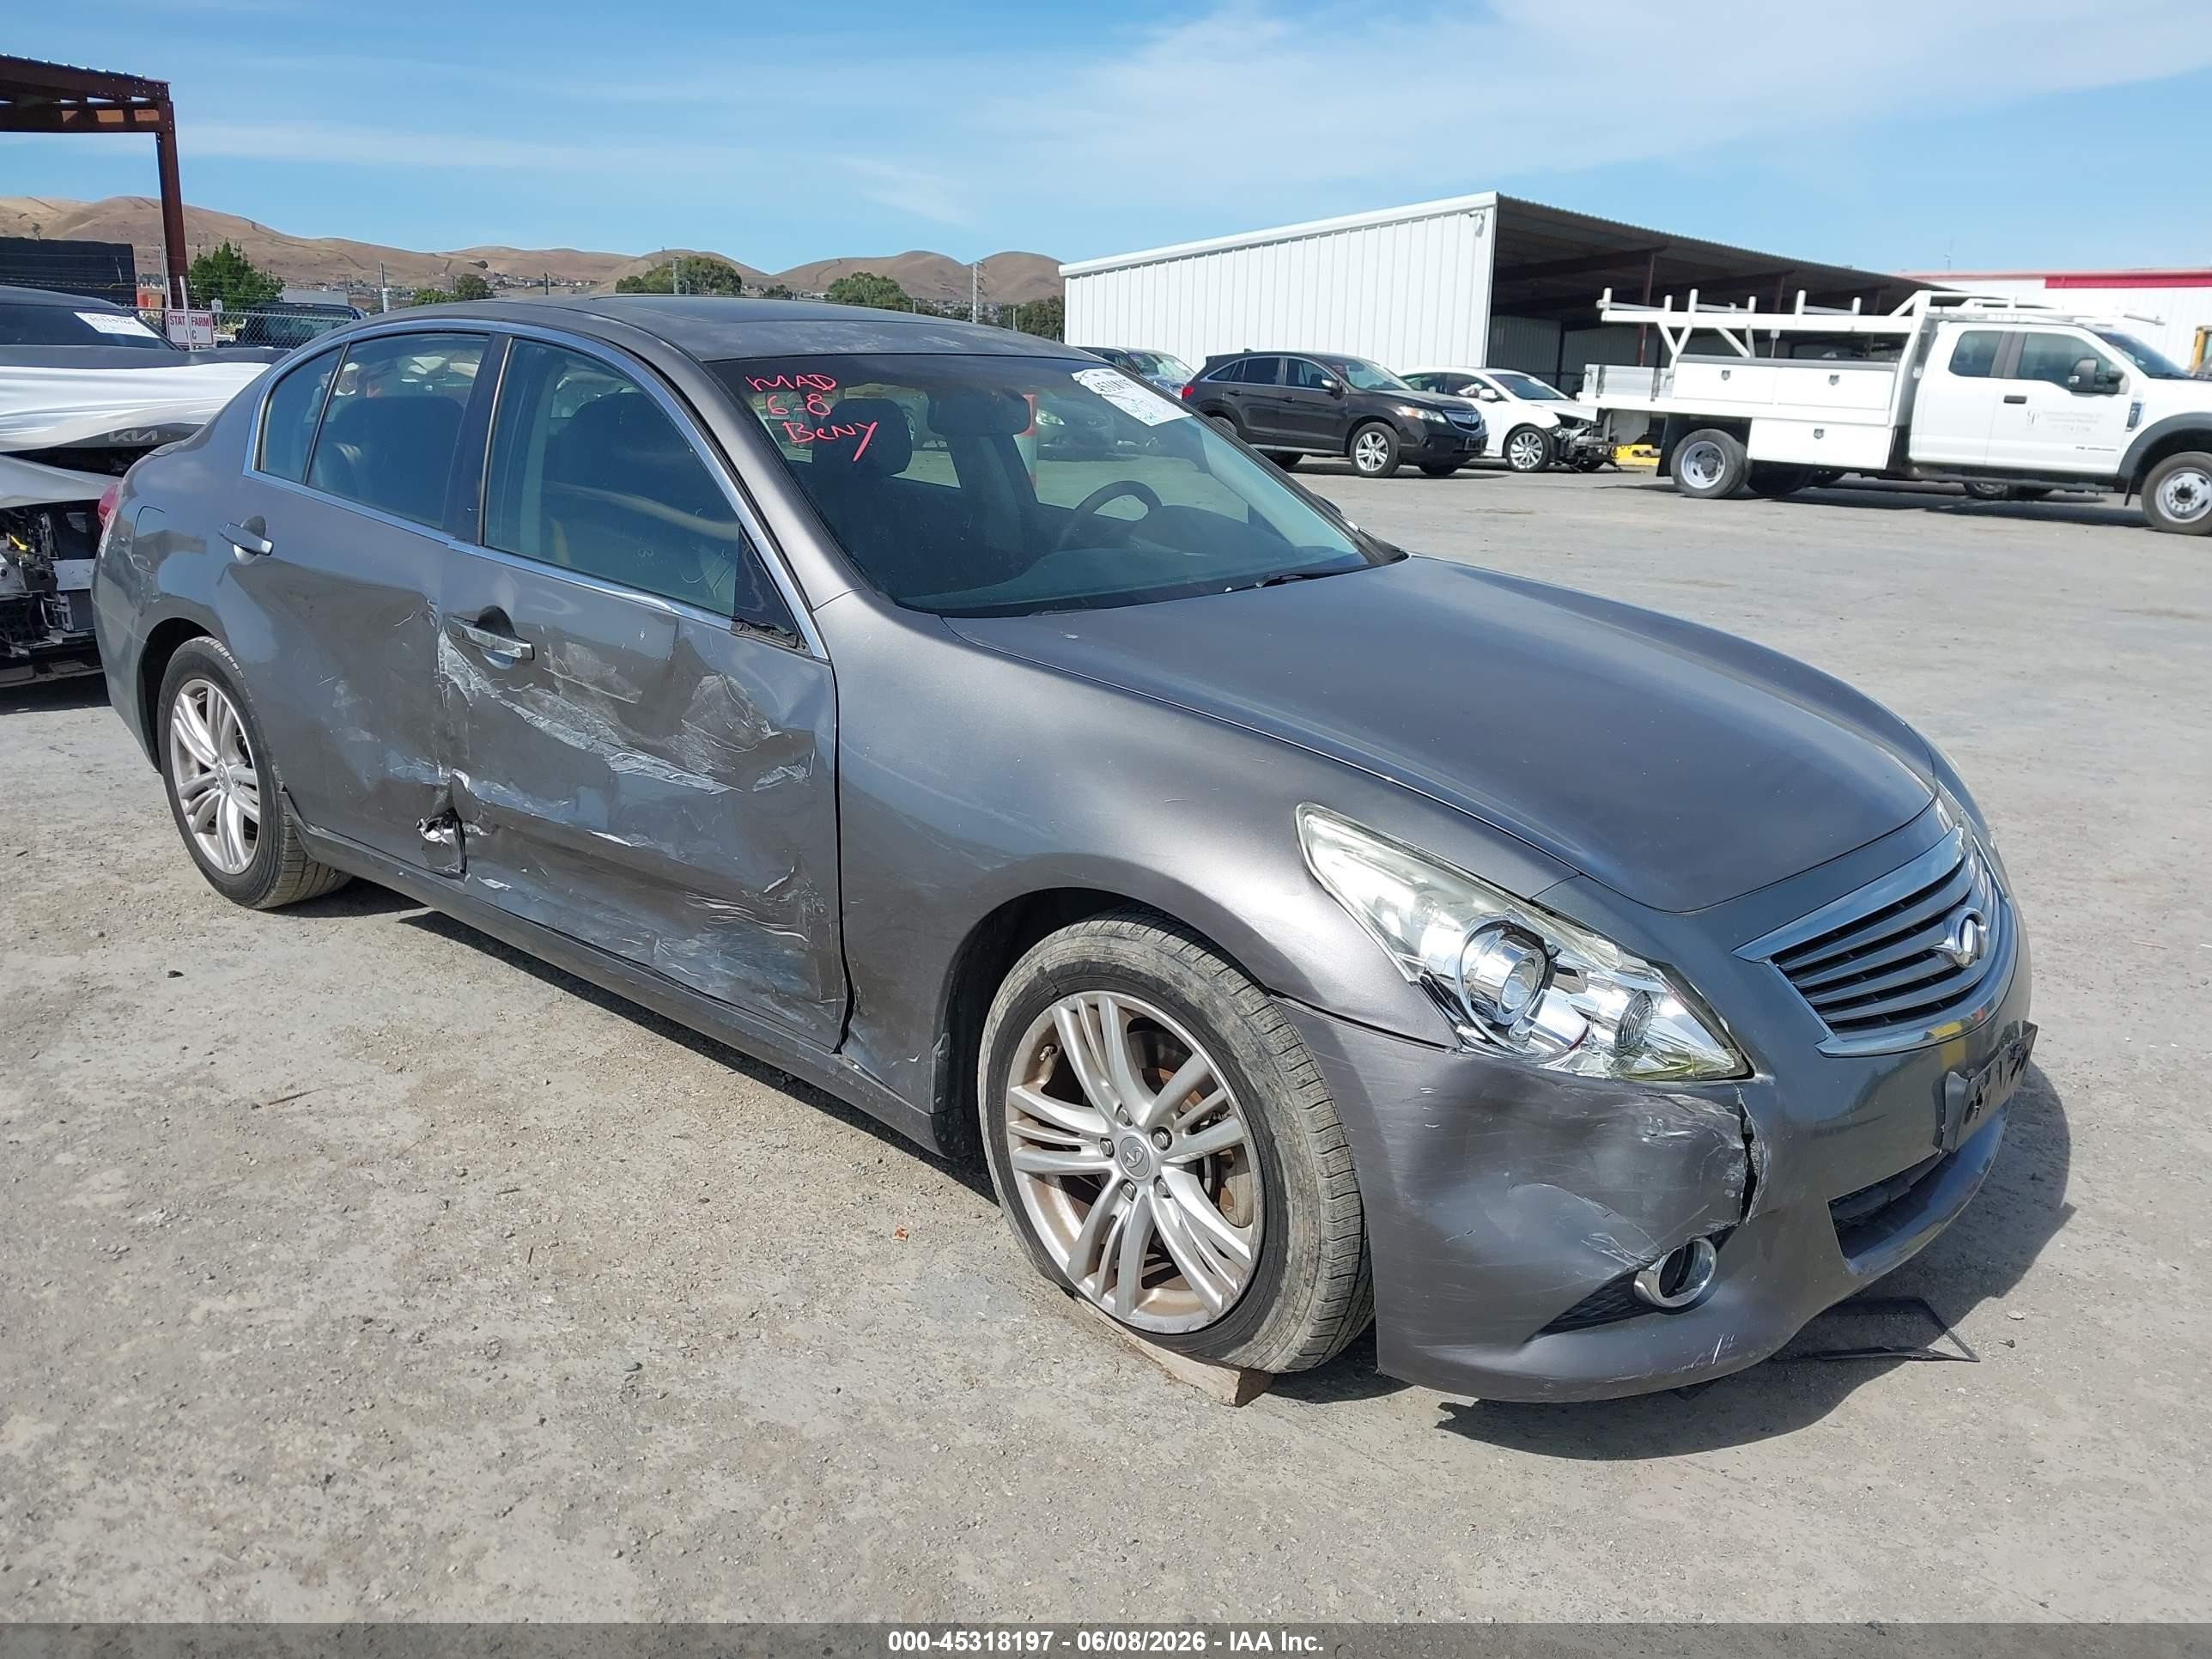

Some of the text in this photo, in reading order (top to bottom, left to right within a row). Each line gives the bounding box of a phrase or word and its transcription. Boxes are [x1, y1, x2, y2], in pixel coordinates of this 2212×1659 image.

[170, 315, 210, 327] STAT FARM
[745, 374, 837, 392] MAD
[767, 392, 831, 416] 6-8
[108, 429, 158, 442] KIA
